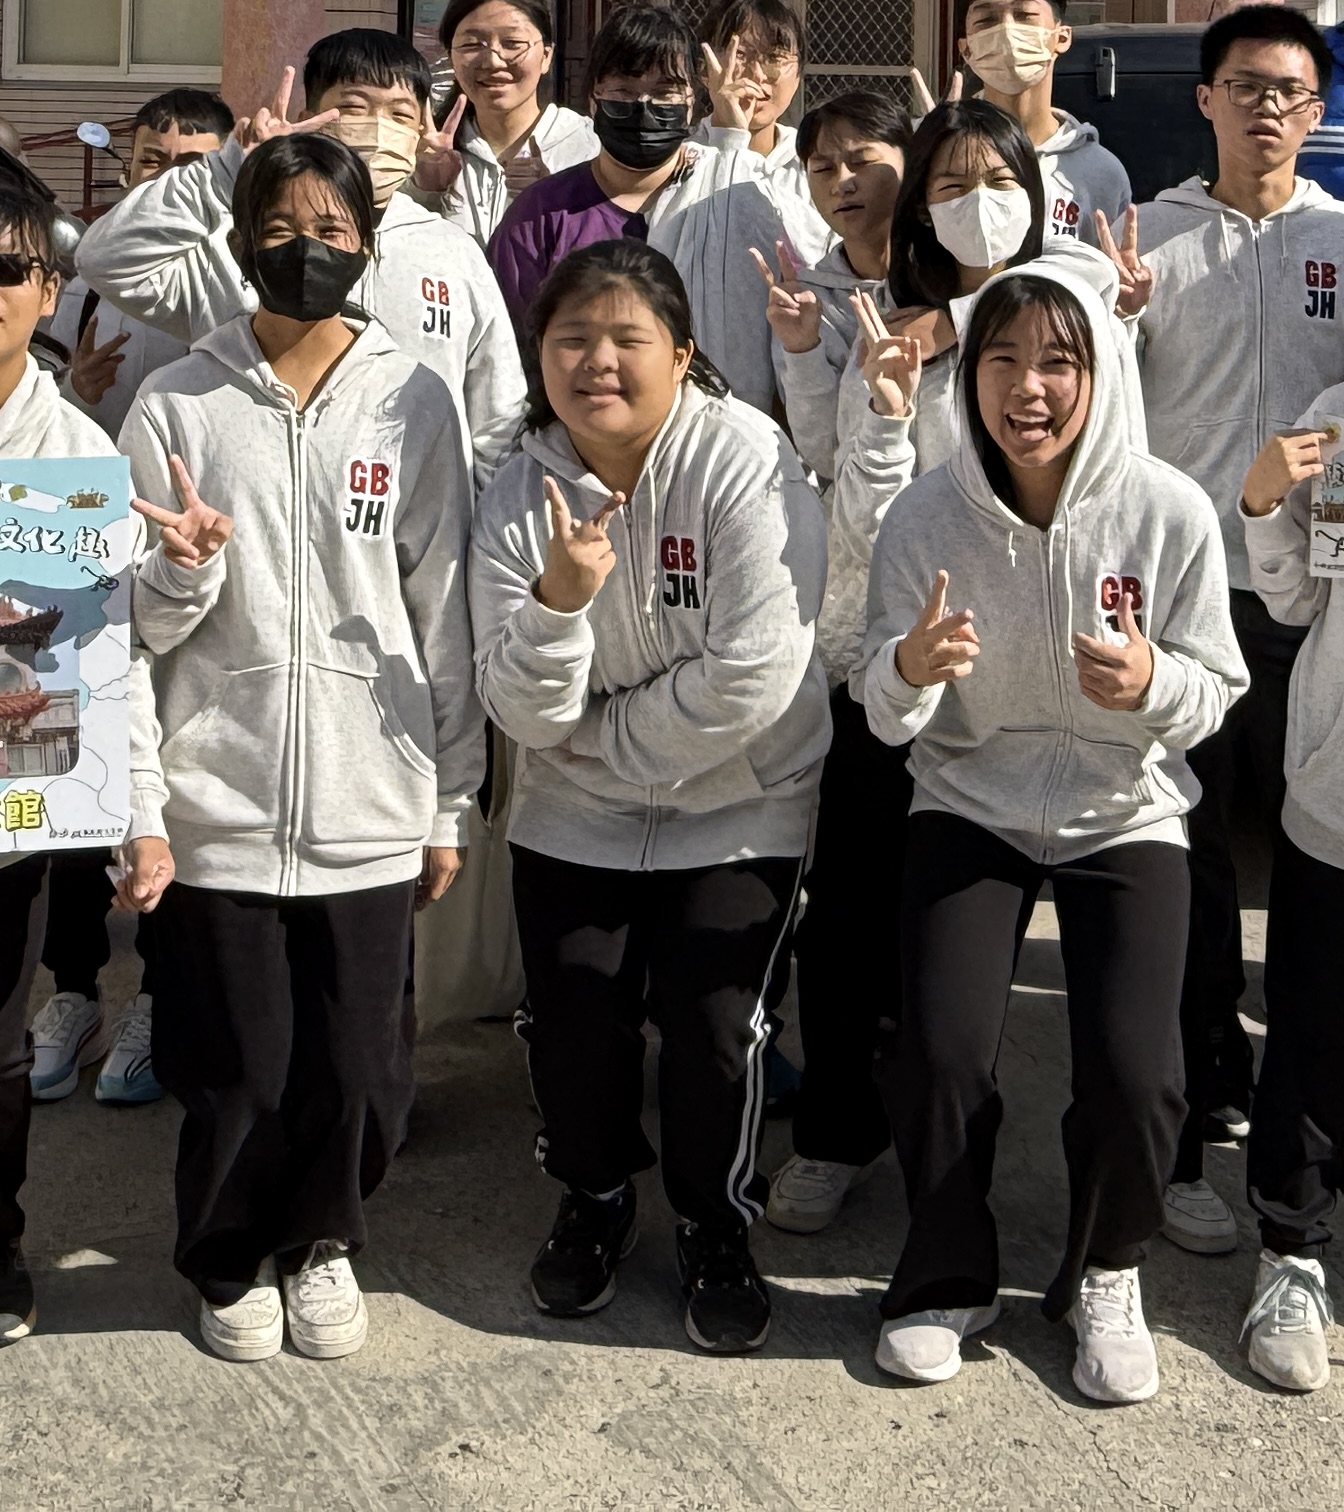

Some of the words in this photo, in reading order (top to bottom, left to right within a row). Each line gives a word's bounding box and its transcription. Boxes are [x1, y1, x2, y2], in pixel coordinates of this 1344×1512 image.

[1053, 198, 1079, 226] GB
[1305, 260, 1337, 289] GB
[421, 277, 450, 306] GB
[1305, 289, 1335, 319] JH
[422, 306, 451, 338] JH
[350, 460, 391, 495] GB
[346, 499, 384, 536] JH
[661, 536, 697, 571] GB
[663, 574, 701, 609] JH
[1101, 576, 1143, 610] GB
